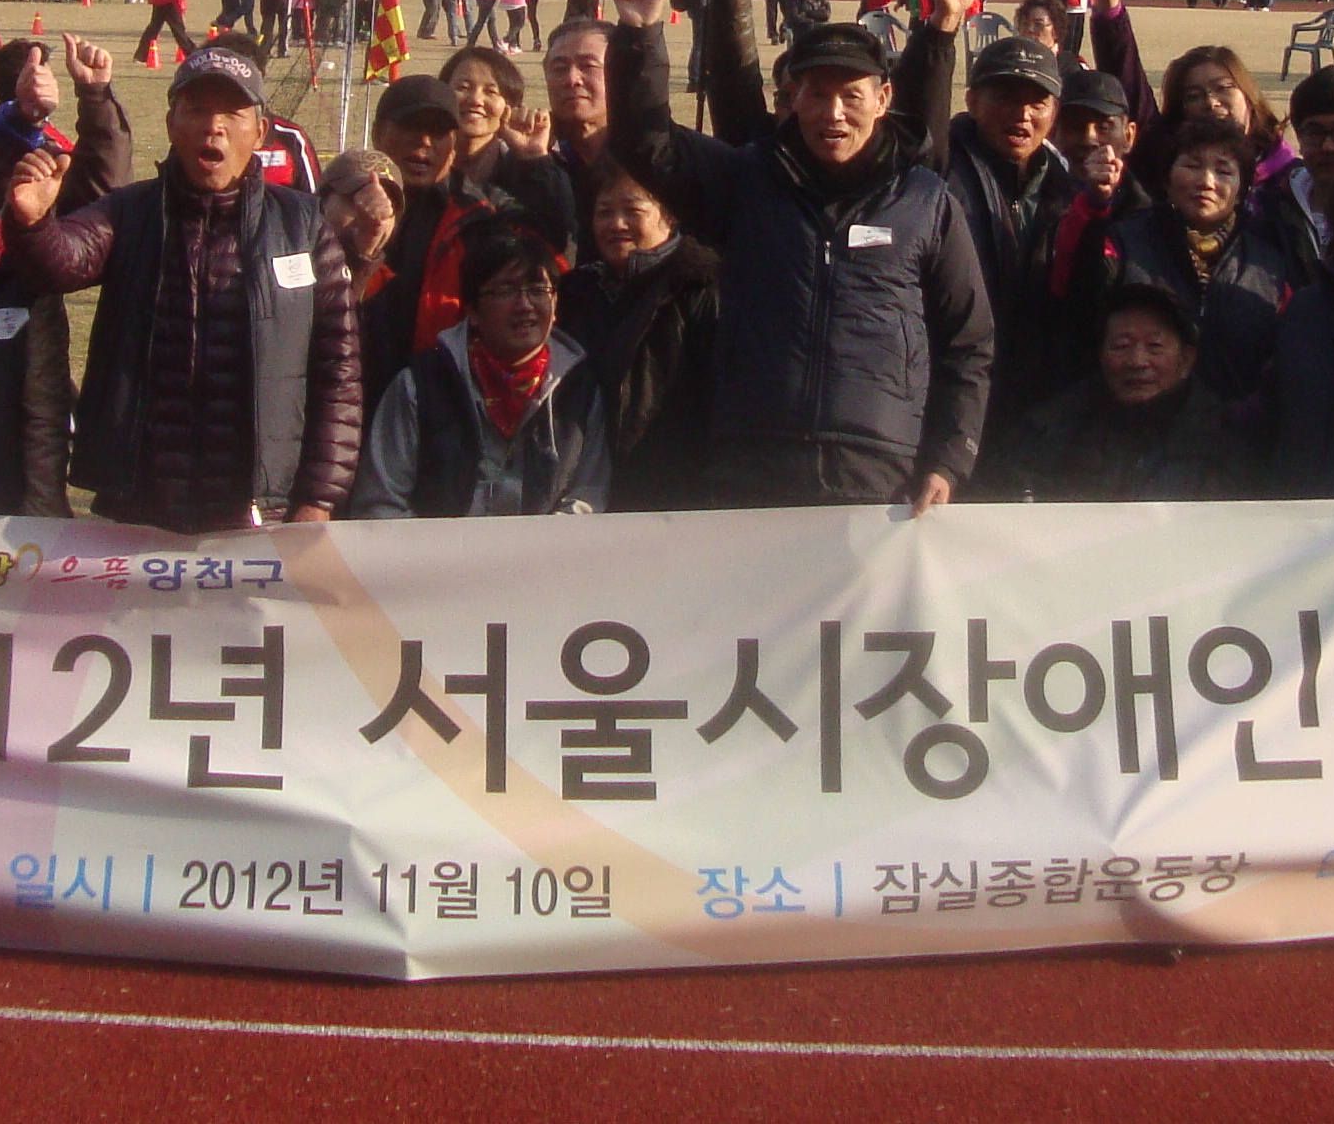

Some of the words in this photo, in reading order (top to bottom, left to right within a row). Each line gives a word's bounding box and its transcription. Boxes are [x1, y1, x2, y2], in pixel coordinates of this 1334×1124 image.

[141, 553, 285, 593] 양천구
[9, 852, 114, 912] 일시
[178, 858, 344, 915] 2012년
[370, 861, 479, 919] 11월
[505, 865, 612, 919] 10일
[696, 862, 806, 919] 장소
[872, 849, 1251, 914] 잠실종합운동장
